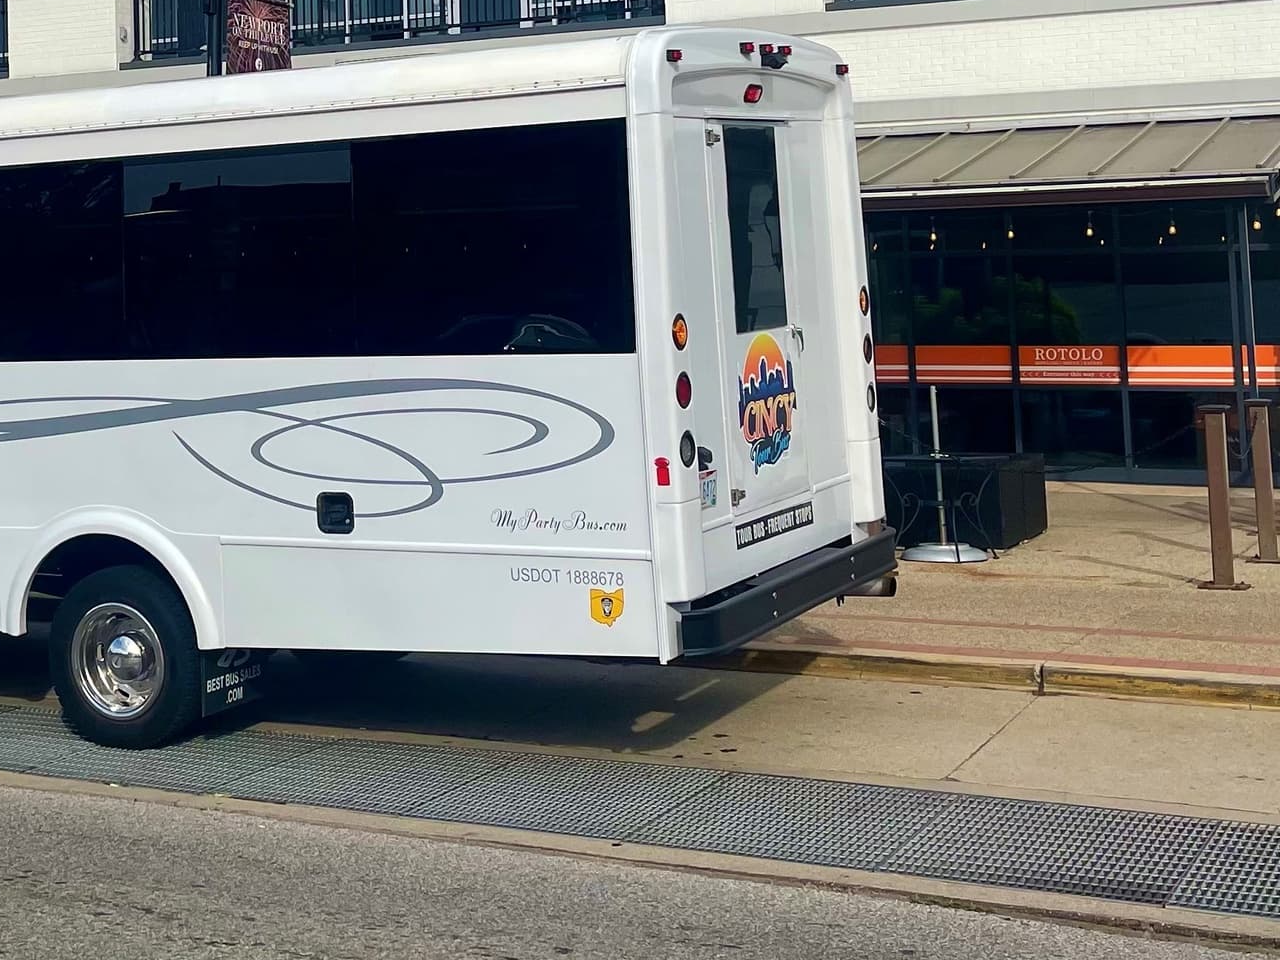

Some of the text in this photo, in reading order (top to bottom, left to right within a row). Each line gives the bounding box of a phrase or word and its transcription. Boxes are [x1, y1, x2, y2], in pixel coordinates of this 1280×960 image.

[233, 12, 285, 36] NEWPORT
[1035, 348, 1103, 361] ROTOLO
[743, 392, 794, 441] CINCY
[751, 438, 772, 475] Tour
[491, 508, 627, 534] MyPartyBus.com
[737, 505, 812, 545] TOUR BUS FREQUENT STOPS
[510, 567, 624, 586] USDOT 1888678
[206, 664, 261, 693] BEST BUS SALES
[225, 686, 243, 704] .COM
